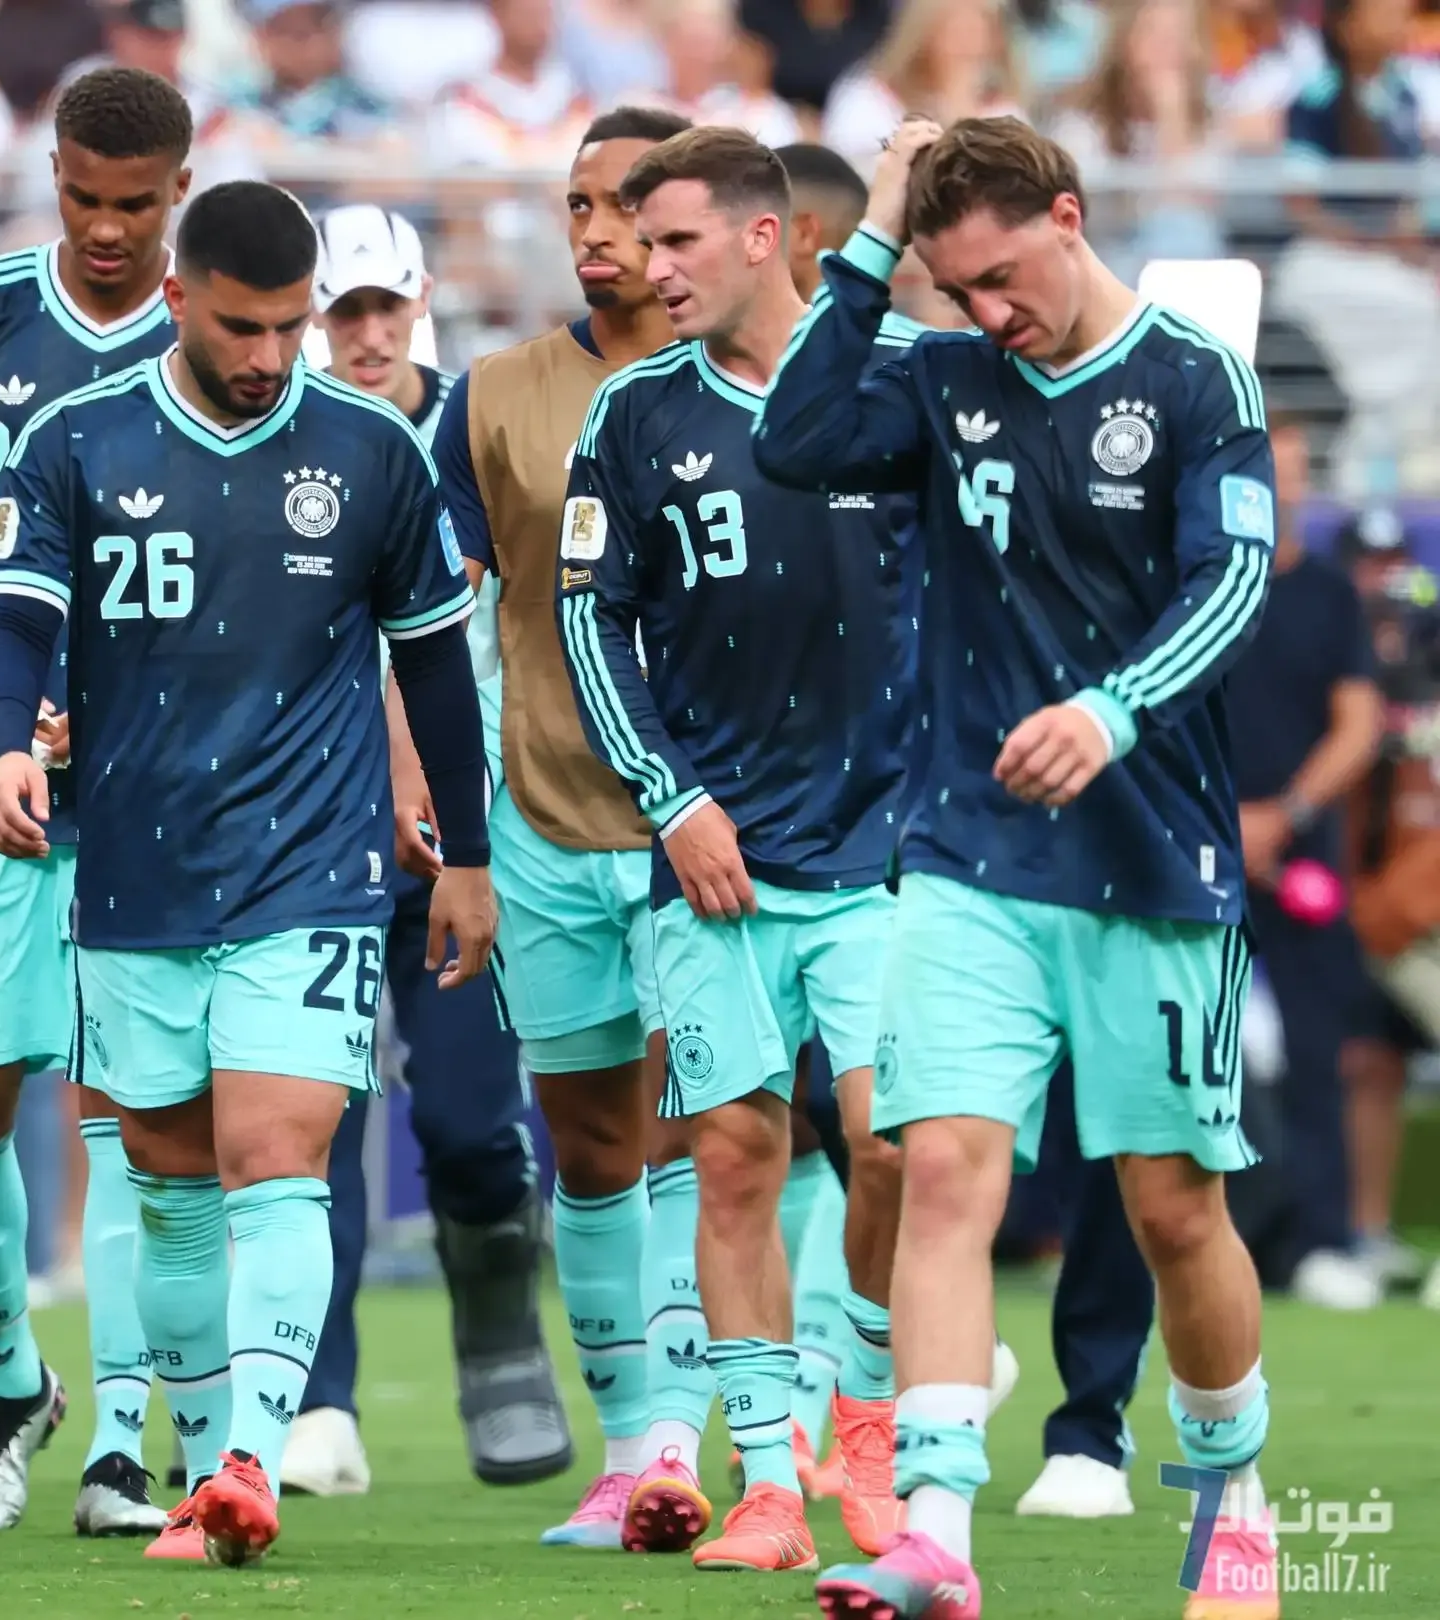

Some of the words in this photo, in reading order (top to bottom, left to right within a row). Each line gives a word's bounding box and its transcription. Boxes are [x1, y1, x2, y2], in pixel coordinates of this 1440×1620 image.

[93, 531, 195, 620] 26
[662, 489, 748, 589] 13
[301, 929, 382, 1018] 26
[274, 1320, 317, 1351] DFB
